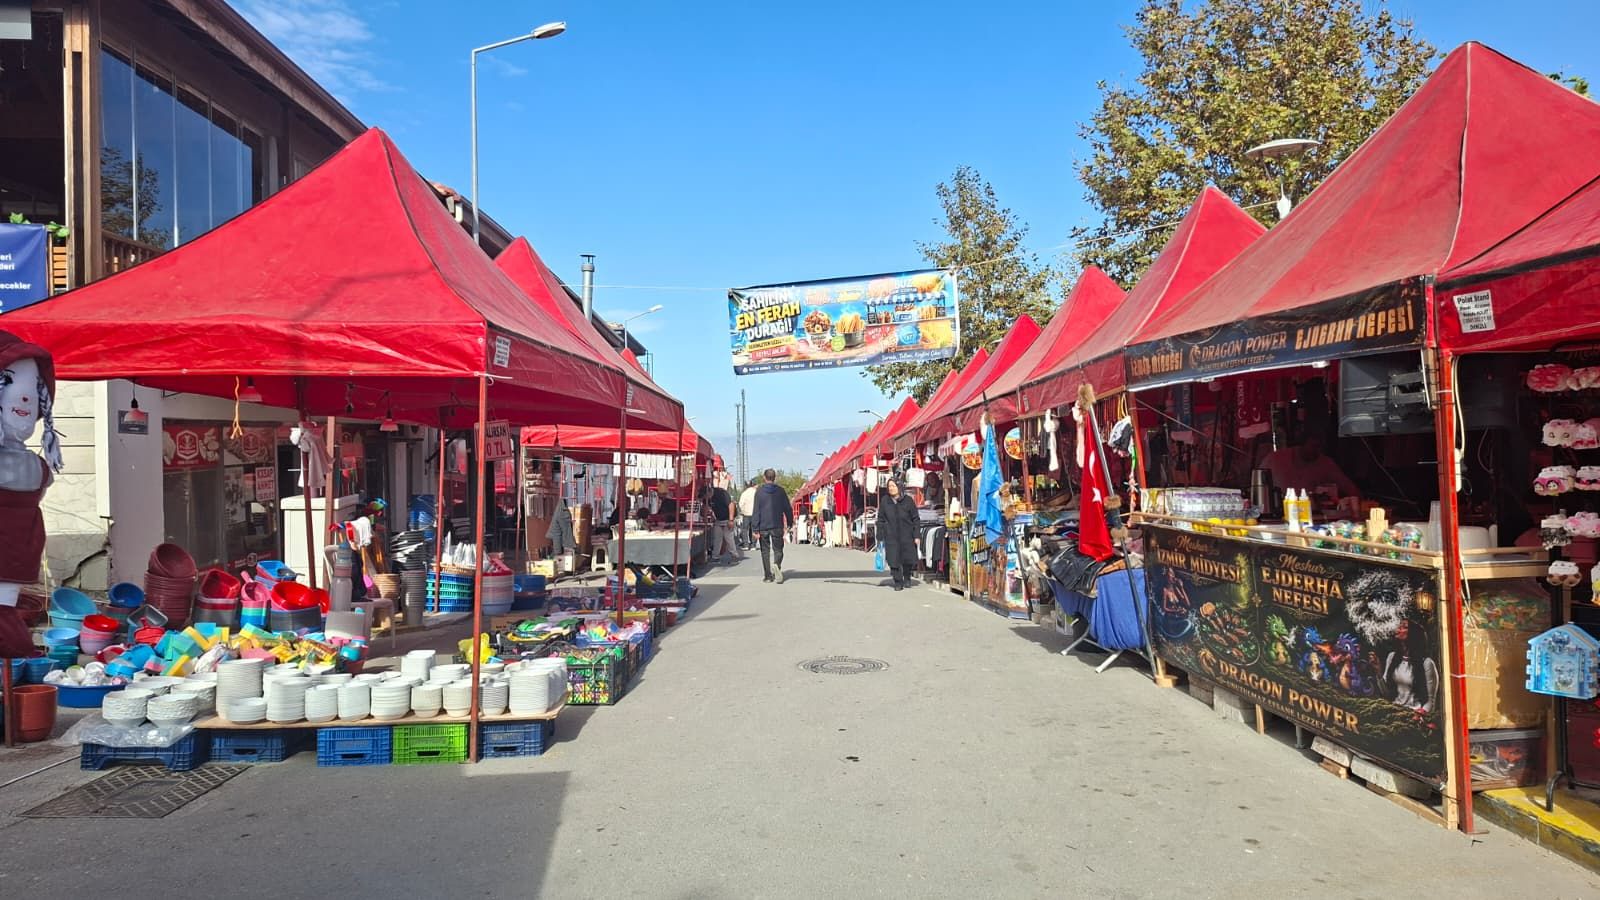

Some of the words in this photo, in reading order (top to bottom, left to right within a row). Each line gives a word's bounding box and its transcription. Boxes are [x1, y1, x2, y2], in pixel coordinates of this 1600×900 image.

[736, 311, 755, 331] EN
[757, 301, 801, 325] FERAH
[1201, 338, 1245, 362] DRAGON
[1245, 330, 1287, 354] POWER
[496, 440, 506, 456] TL
[1156, 545, 1186, 570] İZMİR
[1190, 553, 1241, 584] MİDYESİ
[1261, 566, 1344, 600] EJDERHA
[1272, 586, 1329, 615] NEFESİ
[1220, 661, 1283, 699] DRAGON
[1289, 688, 1360, 734] POWER
[1296, 706, 1326, 730] LEZZET
